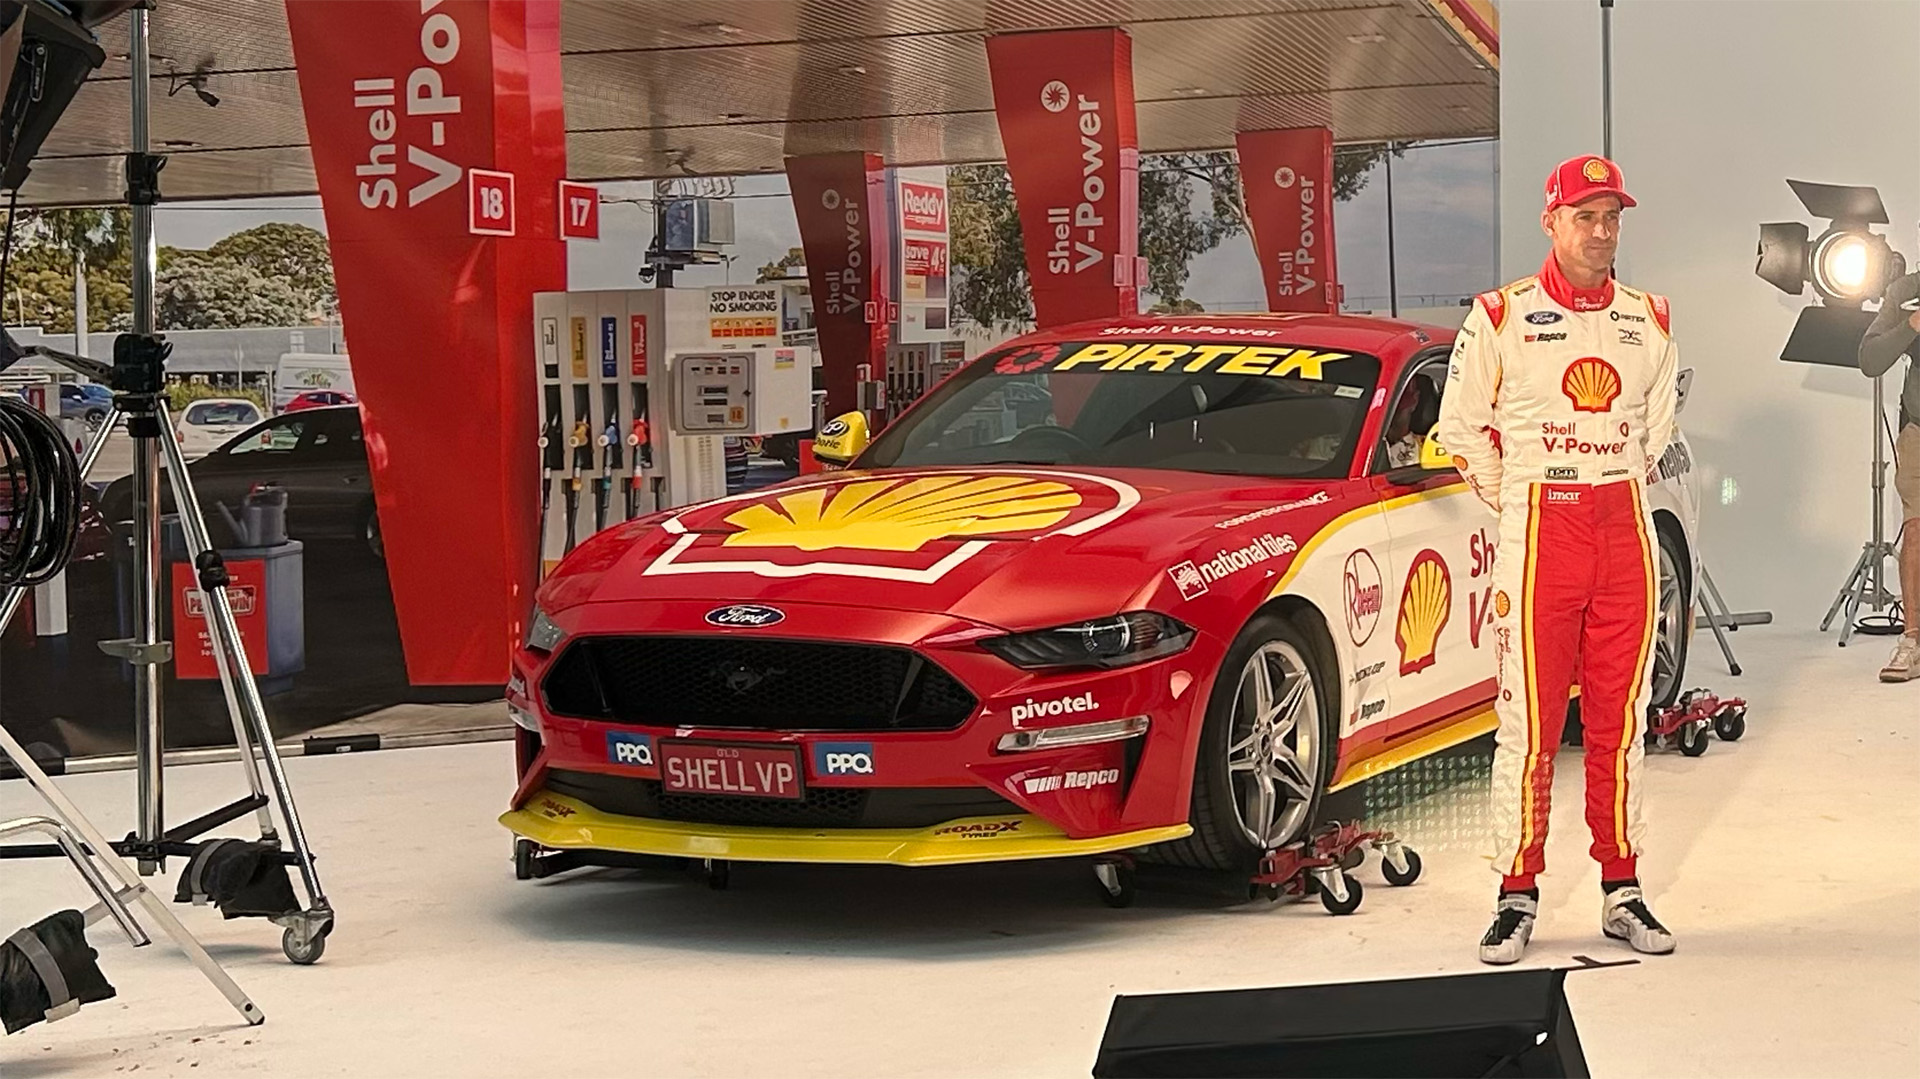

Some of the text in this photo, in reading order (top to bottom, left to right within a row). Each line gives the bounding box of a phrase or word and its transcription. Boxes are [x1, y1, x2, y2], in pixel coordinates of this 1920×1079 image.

[408, 0, 462, 207] V-Po
[355, 78, 397, 210] Shell
[1075, 94, 1103, 274] V-Power
[480, 186, 502, 219] 18
[570, 197, 589, 227] 17
[904, 189, 943, 225] Reddy
[1048, 207, 1070, 275] Shell
[1296, 176, 1315, 296] V-Power
[842, 198, 862, 315] V-Power
[905, 246, 929, 260] save
[1279, 251, 1294, 296] Shell
[711, 290, 776, 302] STOP ENGINE
[825, 271, 840, 315] Shell
[709, 301, 777, 313] NO SMOKING
[1529, 312, 1557, 324] Ford
[1098, 325, 1282, 338] Shell V-Power
[1053, 343, 1353, 381] PIRTEK
[1542, 421, 1576, 435] Shell
[1542, 437, 1627, 456] V-Power
[1547, 488, 1581, 500] imar
[714, 605, 776, 625] Ford
[616, 742, 653, 765] PPQ
[826, 753, 873, 773] PPQ
[1064, 768, 1119, 789] Repco
[934, 820, 1023, 837] ROADX
